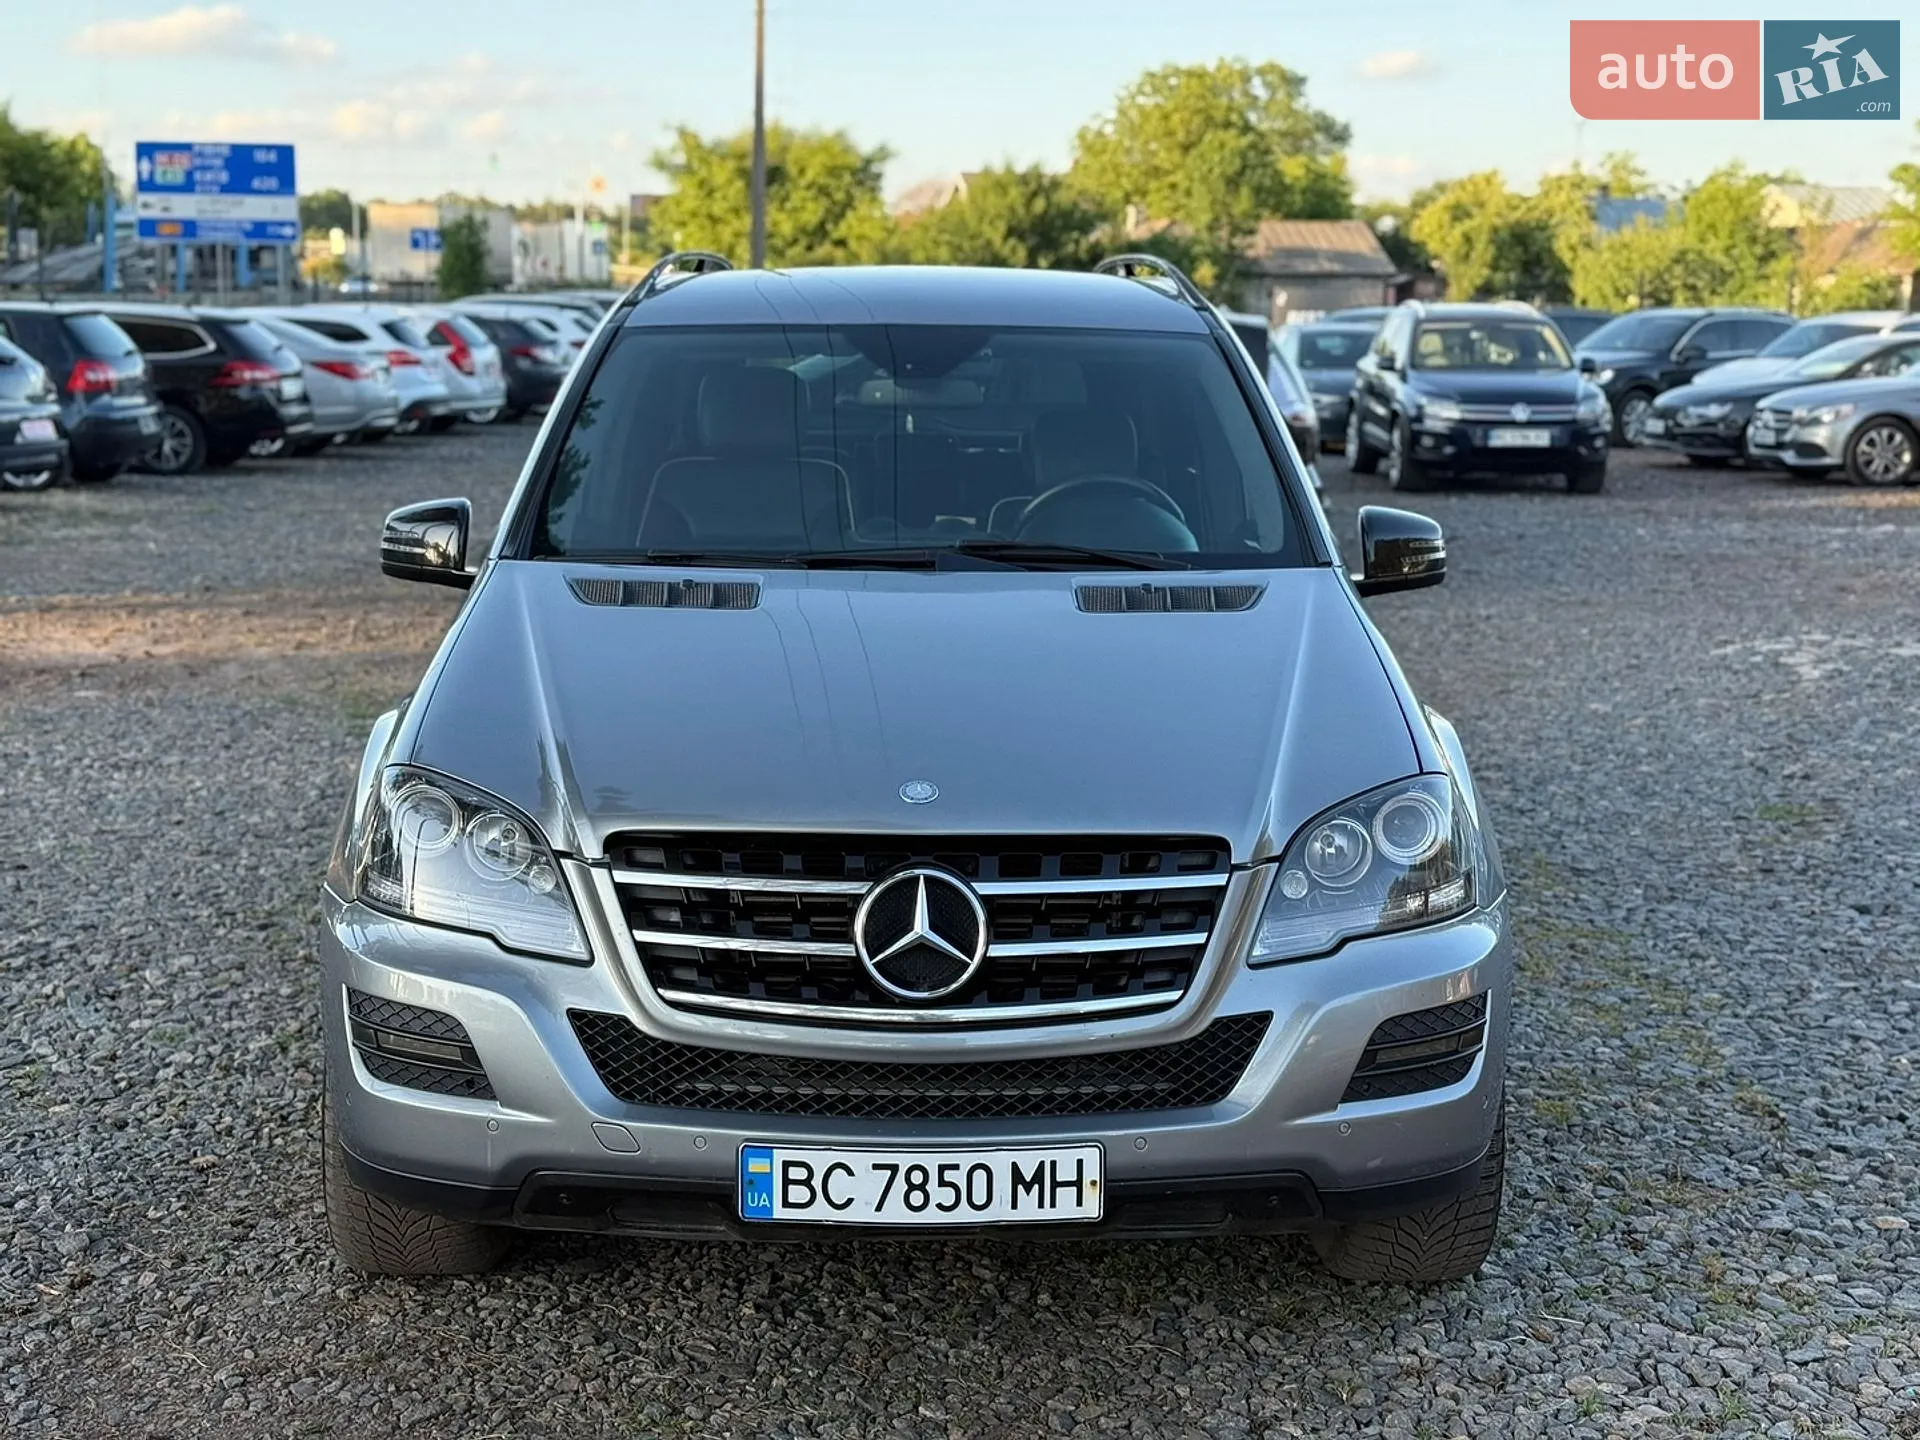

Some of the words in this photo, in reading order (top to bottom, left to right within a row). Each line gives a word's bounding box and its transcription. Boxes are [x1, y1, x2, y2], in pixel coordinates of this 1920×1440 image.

[747, 1191, 770, 1208] UA
[780, 1159, 856, 1211] BC
[871, 1162, 994, 1213] 7850
[1010, 1158, 1084, 1210] MH
